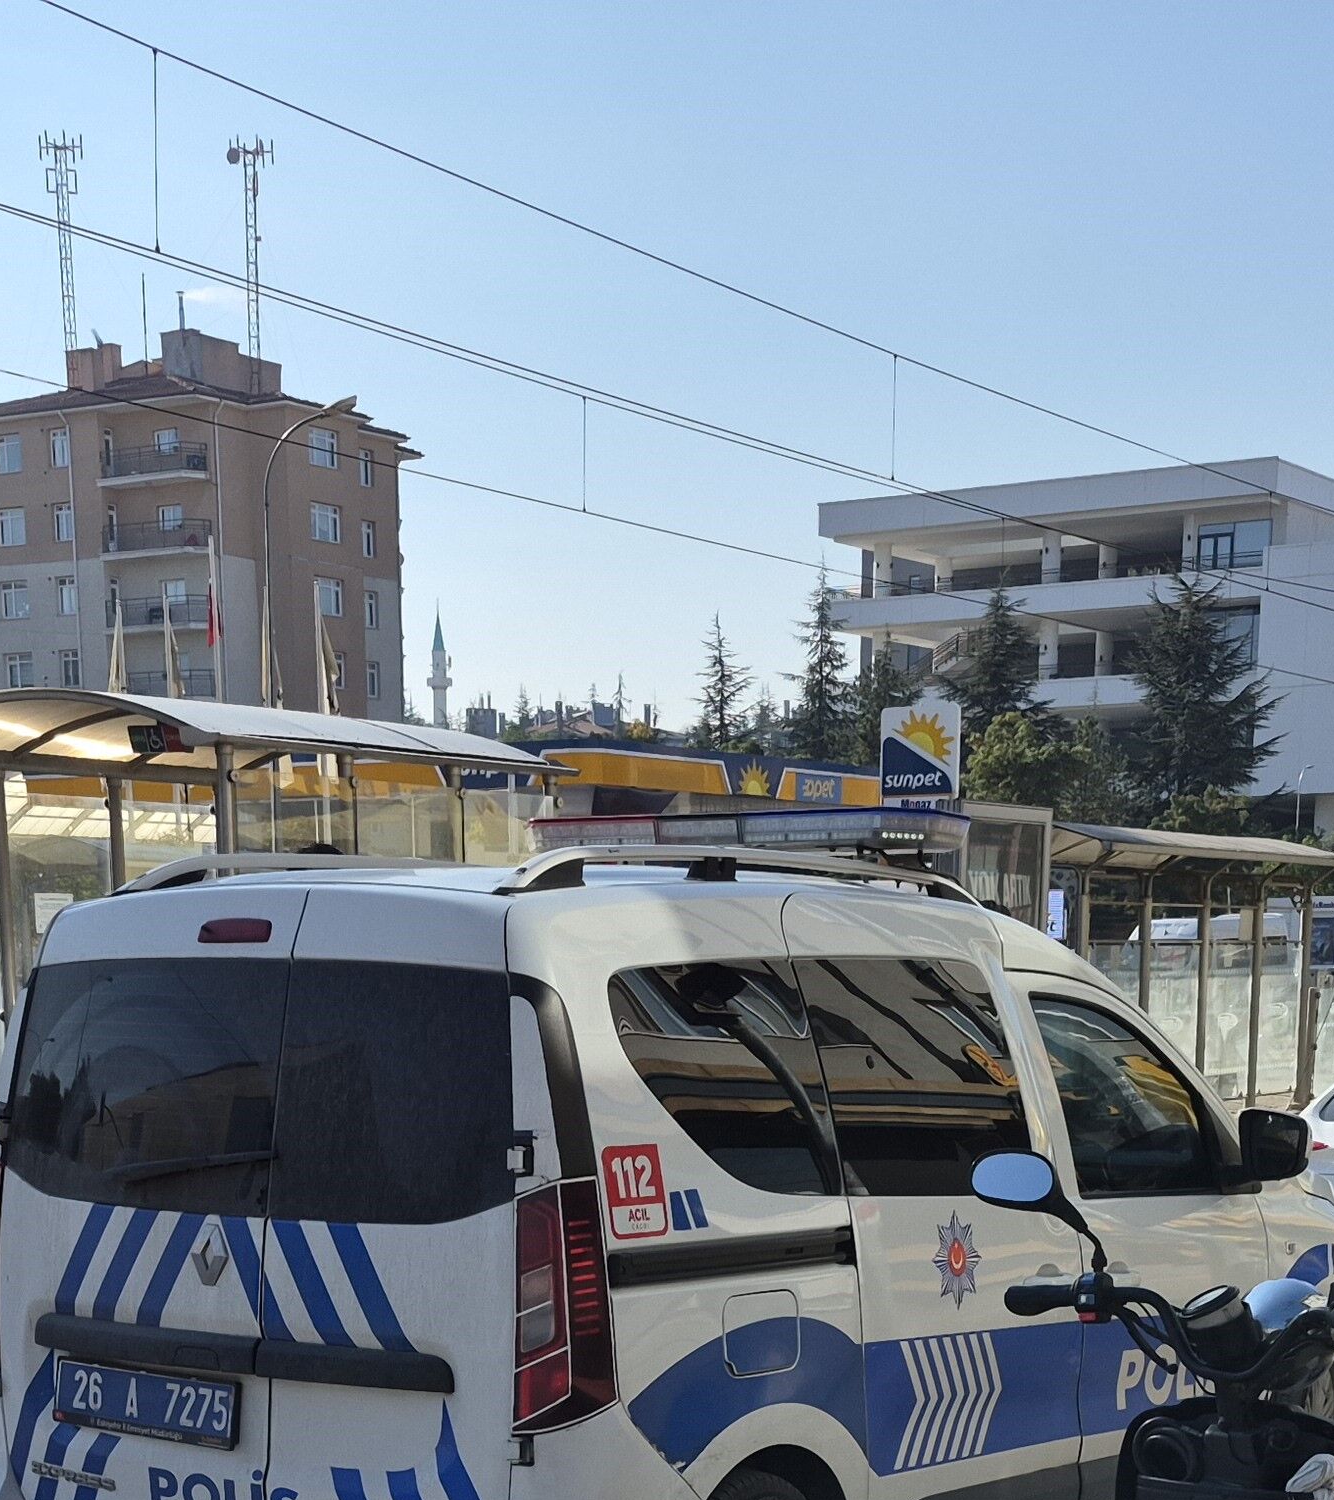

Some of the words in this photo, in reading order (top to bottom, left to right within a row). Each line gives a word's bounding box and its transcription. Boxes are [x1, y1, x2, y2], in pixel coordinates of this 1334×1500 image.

[884, 770, 943, 789] sunpet
[611, 1154, 657, 1199] 112
[72, 1369, 103, 1411] 26
[125, 1377, 139, 1419] A
[164, 1383, 229, 1431] 7275
